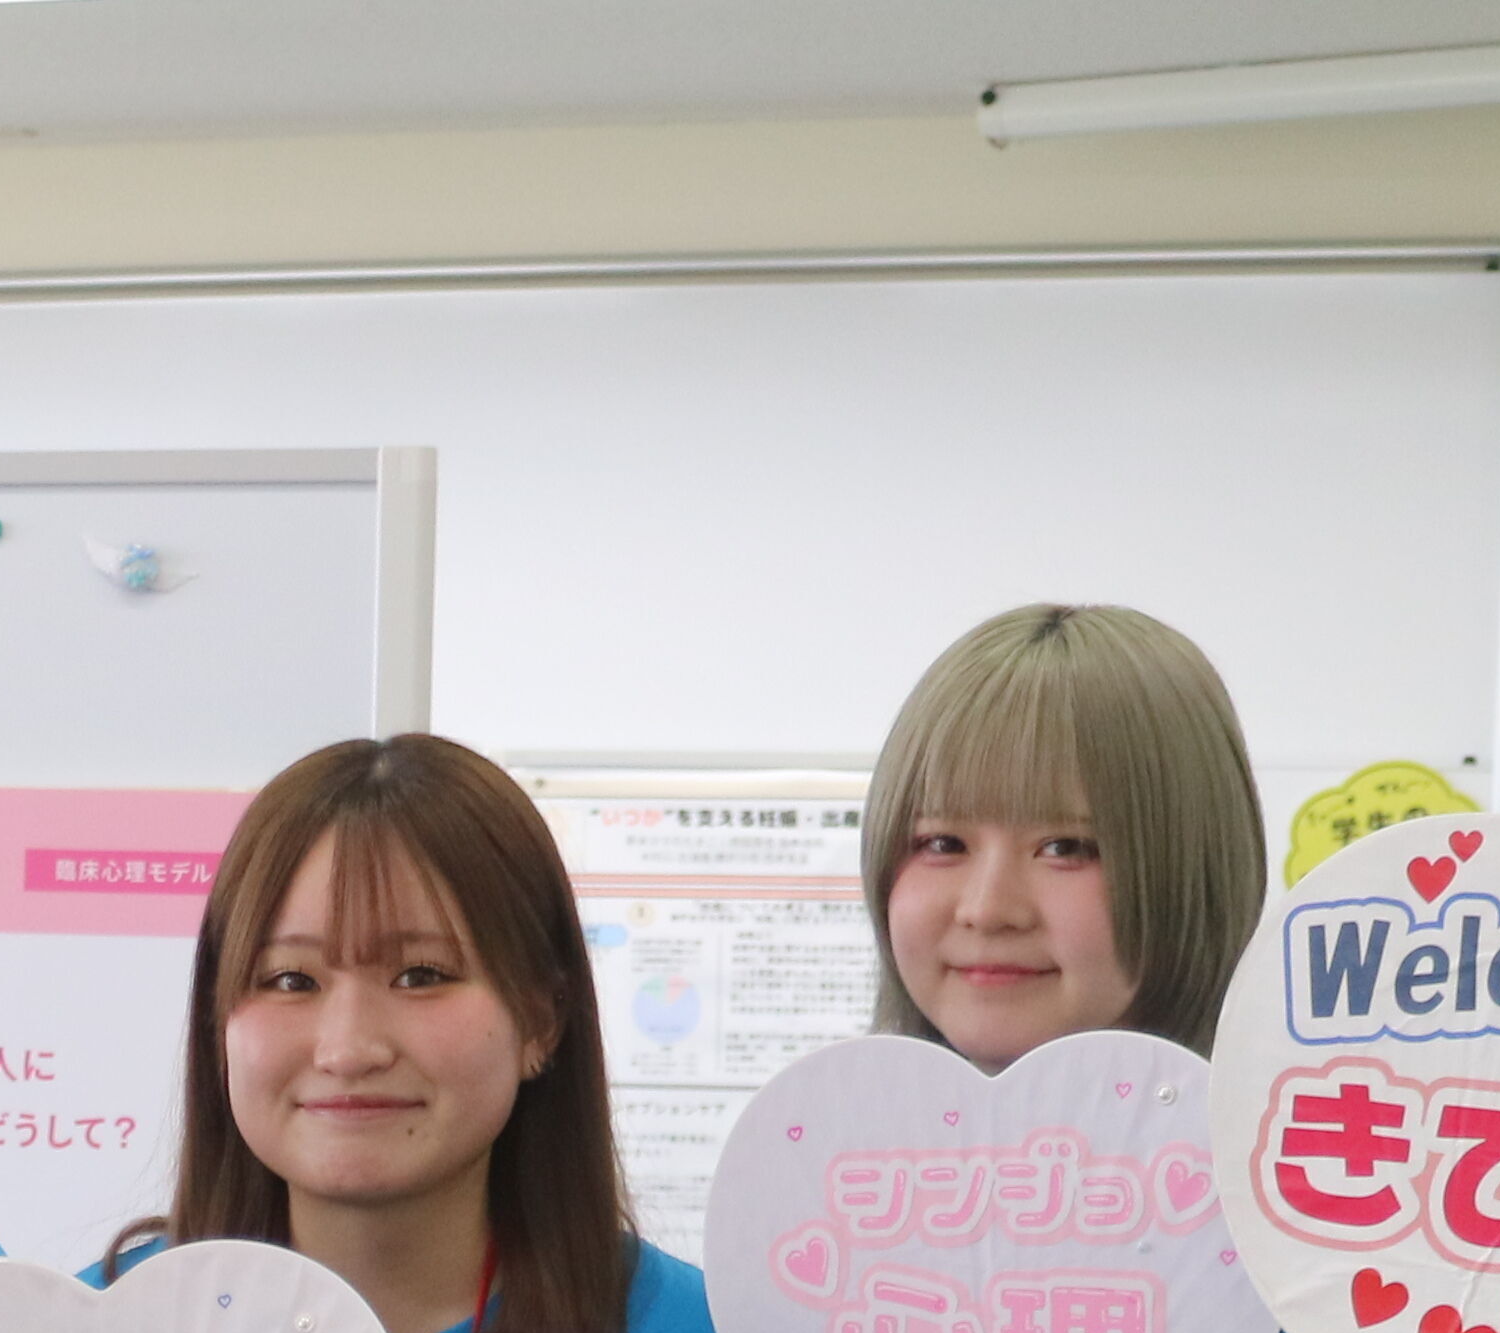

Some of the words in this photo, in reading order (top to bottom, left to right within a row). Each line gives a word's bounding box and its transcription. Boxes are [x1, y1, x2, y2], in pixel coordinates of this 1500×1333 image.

[55, 859, 213, 885] 臨床心理モデル
[837, 1139, 1136, 1235] シンジョ
